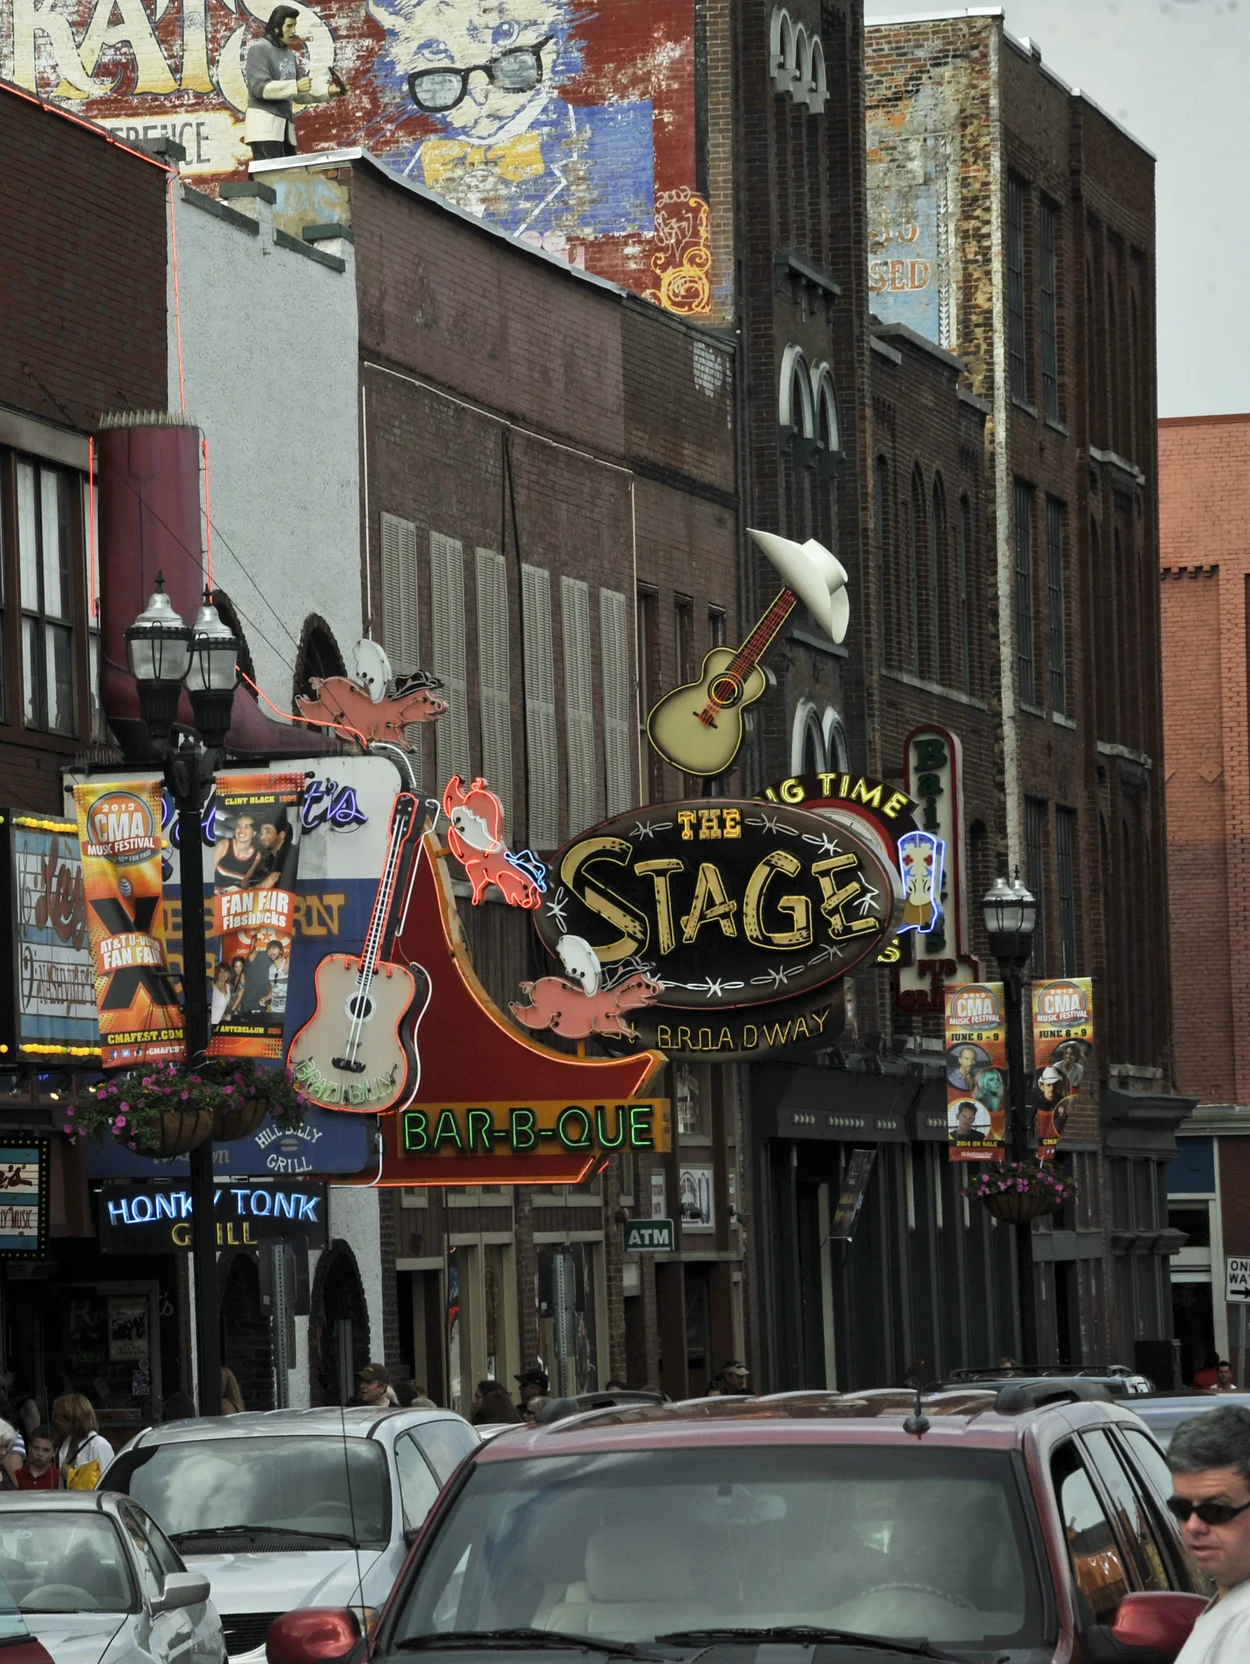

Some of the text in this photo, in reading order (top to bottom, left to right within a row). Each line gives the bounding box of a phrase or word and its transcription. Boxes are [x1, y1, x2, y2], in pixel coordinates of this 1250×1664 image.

[225, 797, 248, 806] CLINT
[250, 795, 275, 805] BLACK
[752, 772, 909, 819] IG TIME
[102, 803, 135, 813] 2013
[94, 812, 145, 843] CMA
[678, 809, 742, 839] THE
[87, 837, 155, 857] MUSIC FESTIVAL
[221, 891, 254, 917] FAN
[561, 836, 880, 962] STAGE
[222, 911, 287, 931] Flashbcks
[100, 935, 127, 955] AT&T
[103, 947, 133, 970] FAN
[956, 997, 994, 1017] CMA
[1044, 994, 1081, 1014] CMA
[949, 1016, 970, 1026] MUSIC
[971, 1014, 1001, 1024] FESTIVAL
[1037, 1013, 1058, 1023] MUSIC
[1059, 1010, 1089, 1020] FESTIVAL
[107, 1029, 184, 1045] CMAFEST.COM
[220, 1025, 265, 1035] ANTEBELLUM
[657, 1006, 832, 1052] BROADWAY
[951, 1033, 975, 1042] JUNE
[977, 1032, 984, 1041] 6
[993, 1032, 1000, 1041] 9
[1039, 1029, 1063, 1039] JUNE
[1065, 1029, 1072, 1038] 6
[1081, 1028, 1088, 1037] 9
[255, 1123, 323, 1149] HILL BLLY
[402, 1104, 657, 1153] BAR-B-QUE
[972, 1140, 981, 1148] ON
[982, 1140, 998, 1148] SALE
[266, 1153, 313, 1174] GRILL
[230, 1188, 322, 1223] TONK
[10, 1207, 33, 1229] MUSIC
[171, 1221, 259, 1247] GILL
[628, 1230, 670, 1247] ATM
[1230, 1260, 1250, 1272] ON
